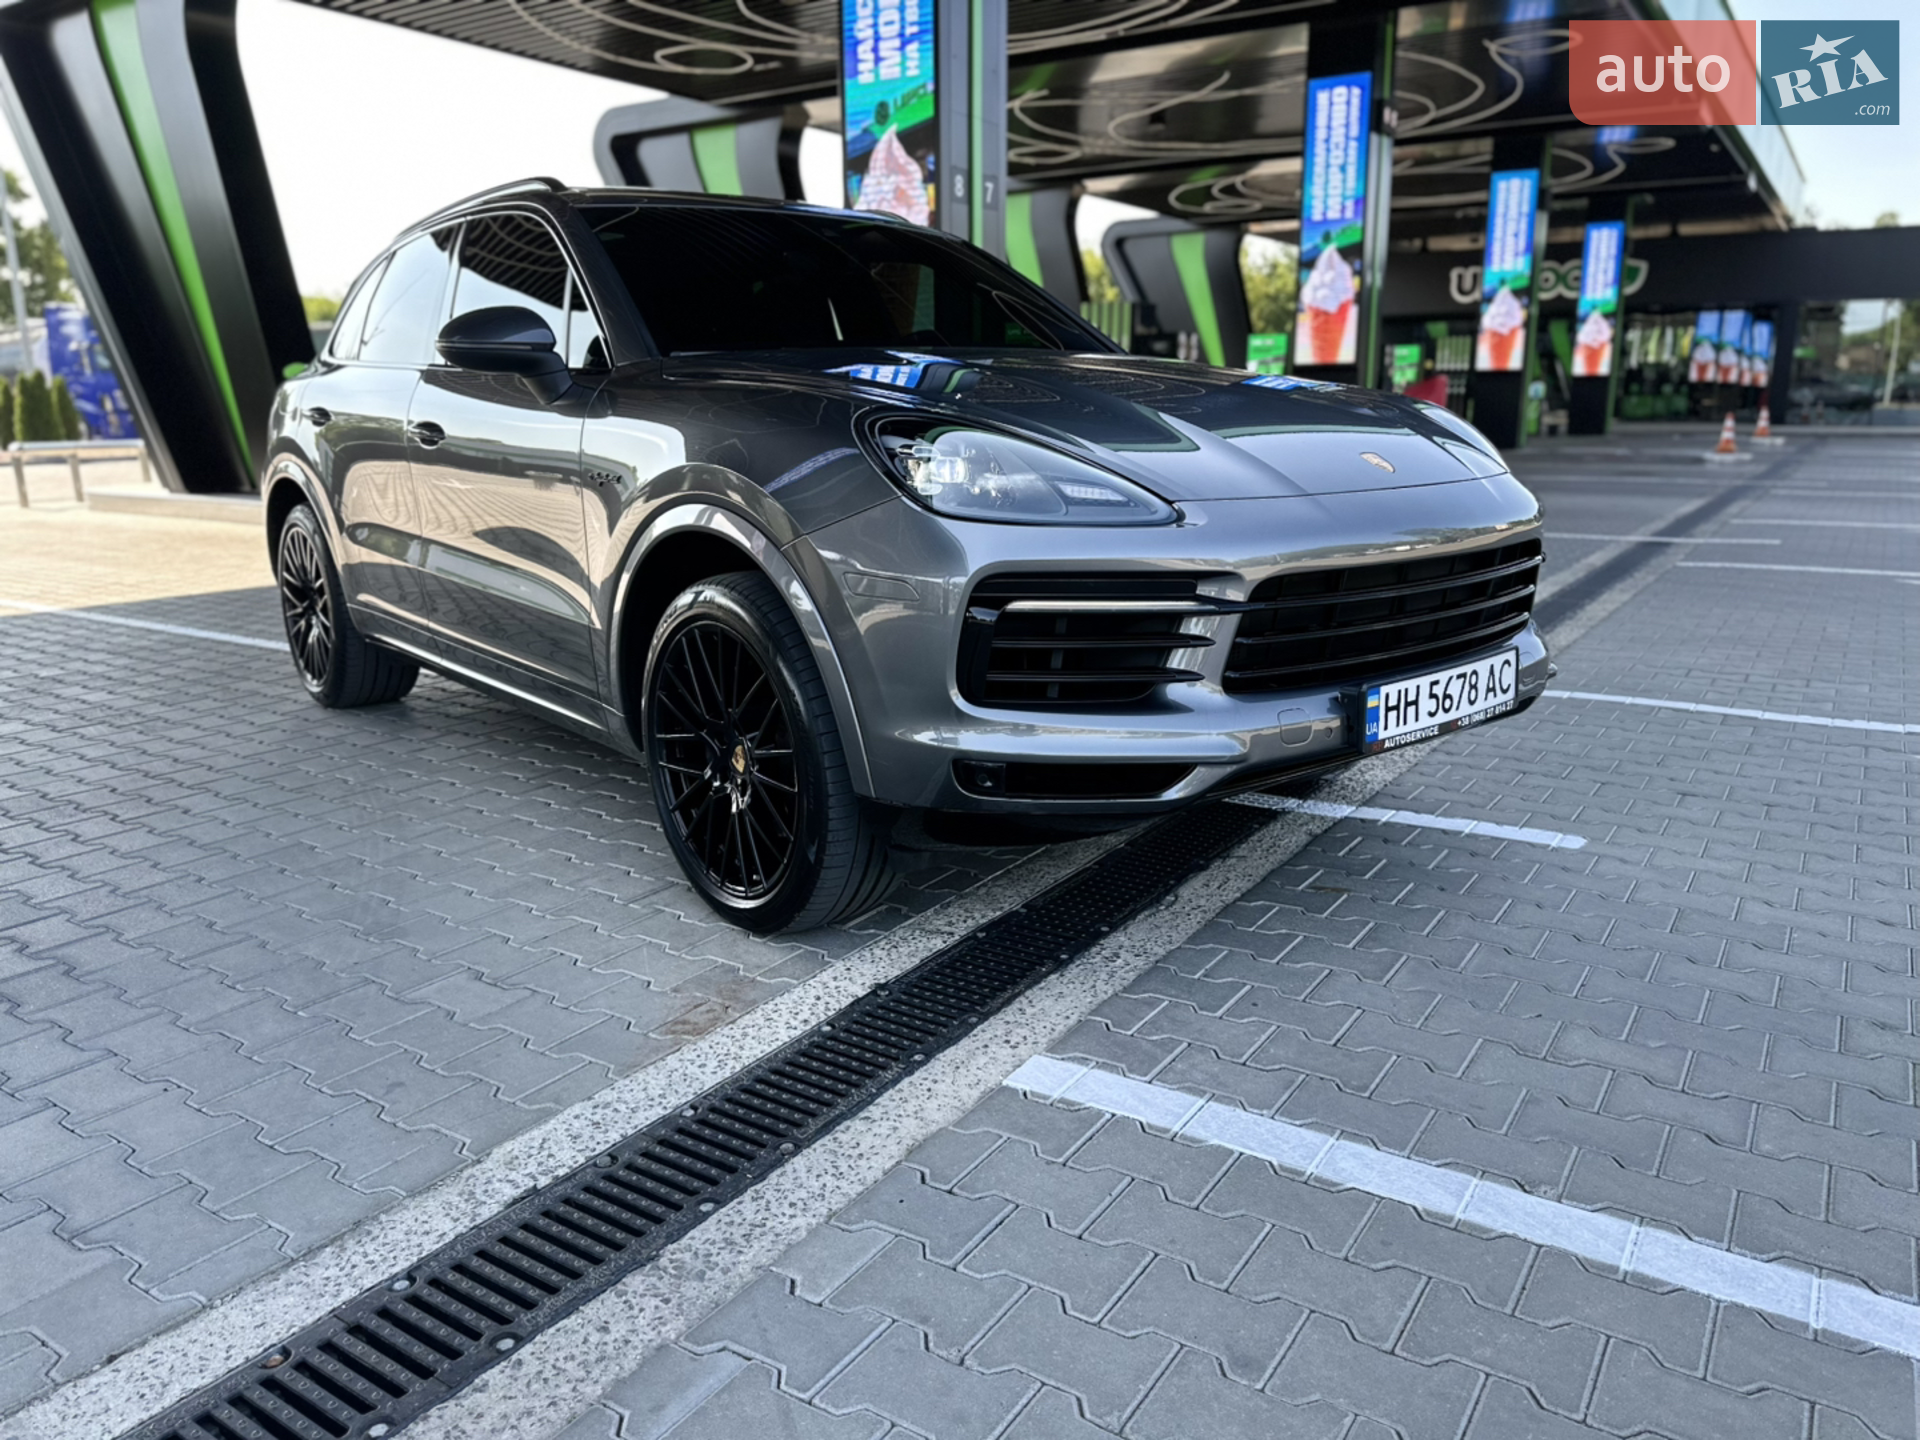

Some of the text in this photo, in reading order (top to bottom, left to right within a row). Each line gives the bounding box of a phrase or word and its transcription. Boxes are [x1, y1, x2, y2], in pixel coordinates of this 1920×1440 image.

[905, 41, 920, 77] НА
[954, 174, 965, 198] 8
[985, 181, 994, 204] 7
[1384, 658, 1512, 731] HH 5678 AC
[1366, 722, 1378, 735] UA
[1383, 725, 1439, 749] AUTOSERVICE
